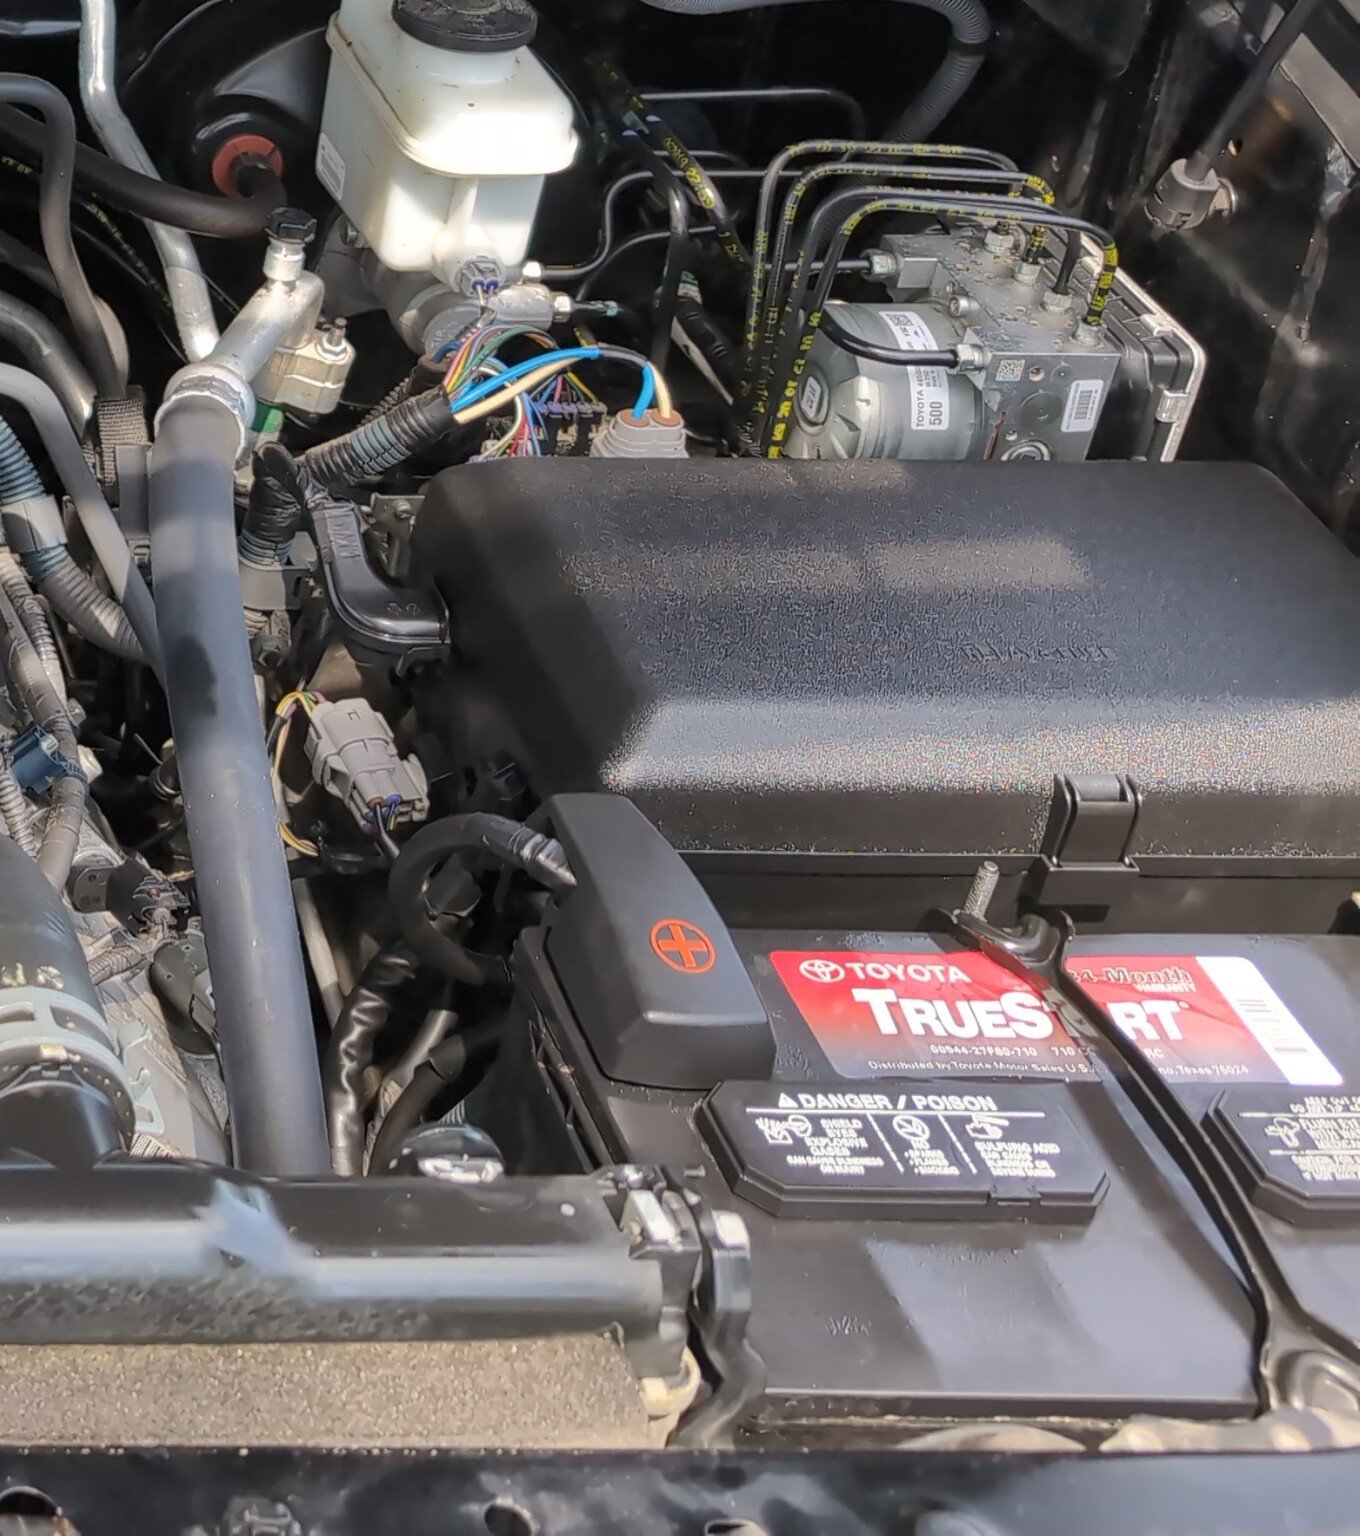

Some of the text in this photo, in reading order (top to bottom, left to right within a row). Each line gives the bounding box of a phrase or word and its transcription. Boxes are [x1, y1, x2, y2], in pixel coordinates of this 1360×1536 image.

[915, 389, 925, 428] TOYOTA
[929, 400, 943, 426] 500
[845, 962, 973, 985] TOYOTA
[1100, 966, 1194, 984] Month
[798, 1093, 893, 1109] DANGER
[912, 1095, 998, 1111] POISON
